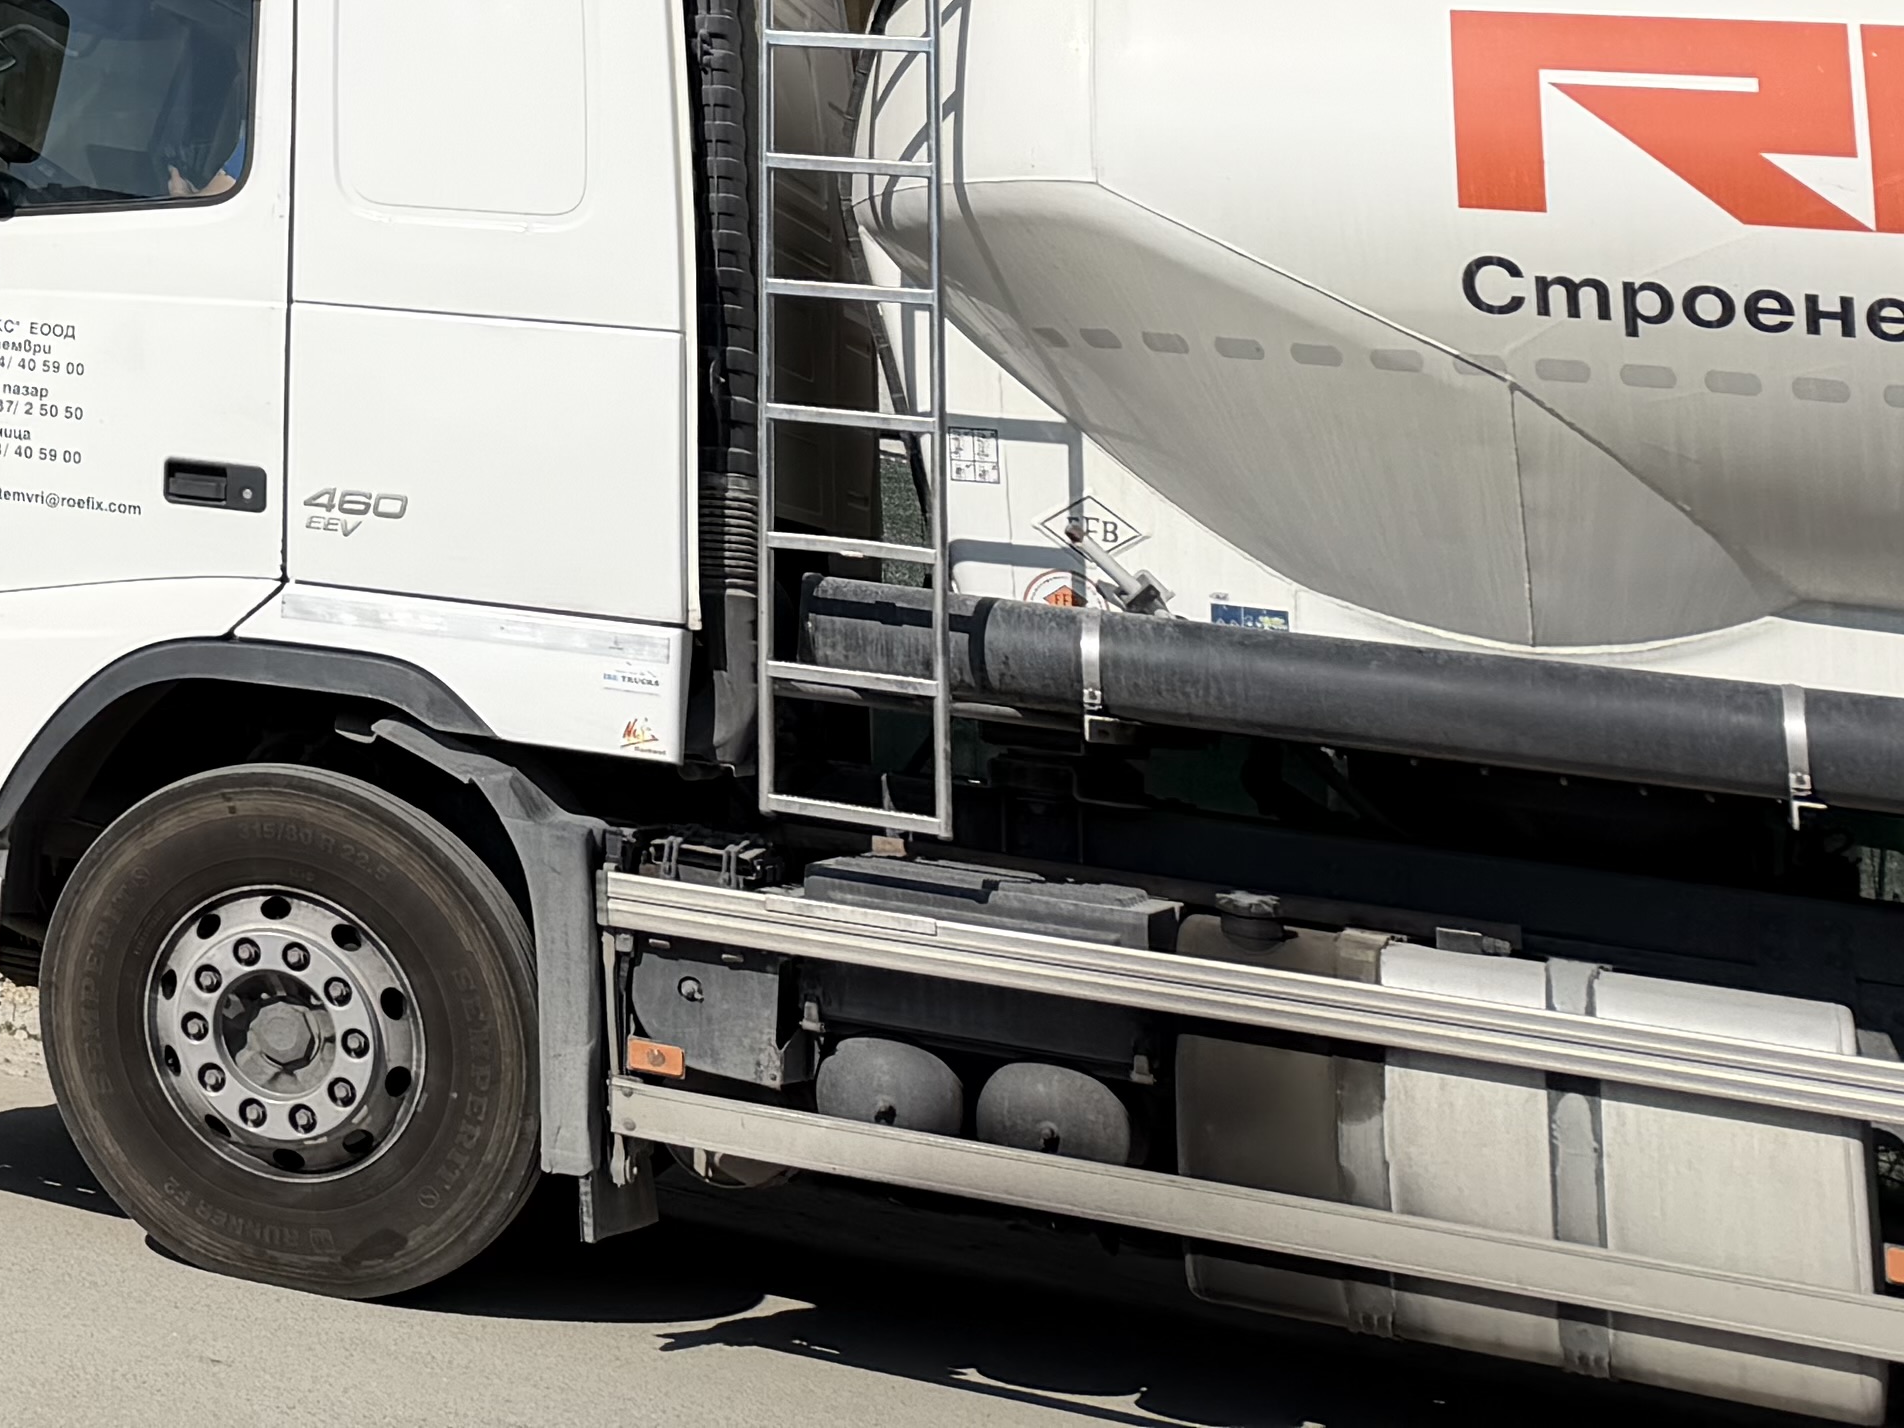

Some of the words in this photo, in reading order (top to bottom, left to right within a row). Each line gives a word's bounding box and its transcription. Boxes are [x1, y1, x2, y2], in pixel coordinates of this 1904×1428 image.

[1461, 255, 1904, 344] Строене
[29, 322, 76, 340] ЕООД
[18, 358, 36, 372] 40
[42, 360, 60, 374] 59
[66, 362, 85, 376] 00
[3, 383, 49, 401] пазар
[24, 402, 33, 415] 2
[40, 404, 58, 418] 50
[64, 406, 83, 420] 50
[14, 446, 33, 460] 40
[39, 448, 57, 461] 59
[63, 450, 82, 464] 00
[303, 487, 408, 519] 460
[305, 515, 362, 537] EEV
